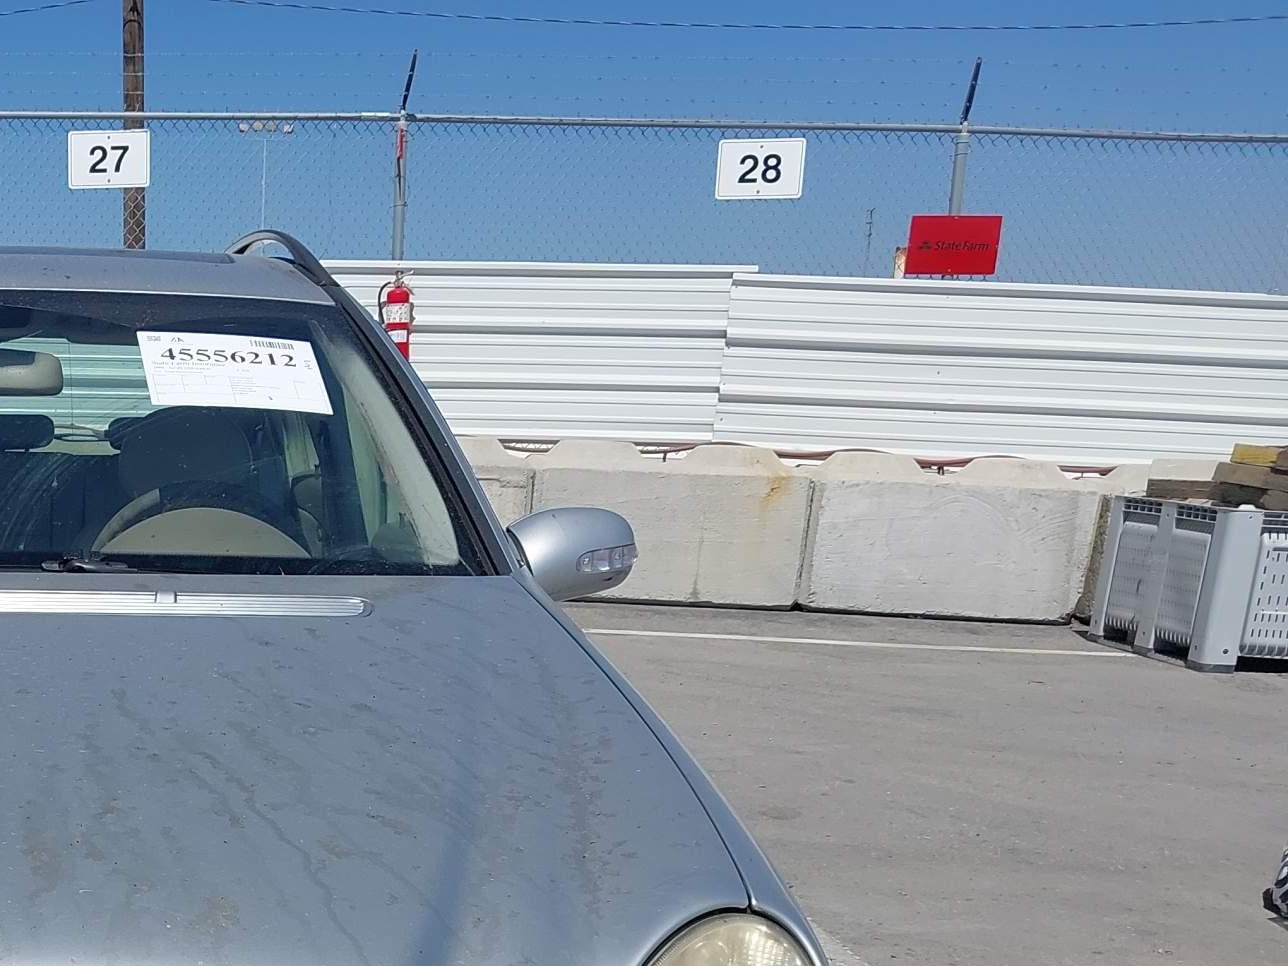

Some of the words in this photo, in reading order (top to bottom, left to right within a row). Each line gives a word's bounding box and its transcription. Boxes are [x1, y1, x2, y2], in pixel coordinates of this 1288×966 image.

[88, 145, 130, 173] 27
[737, 153, 782, 183] 28
[160, 347, 297, 368] 45556212
